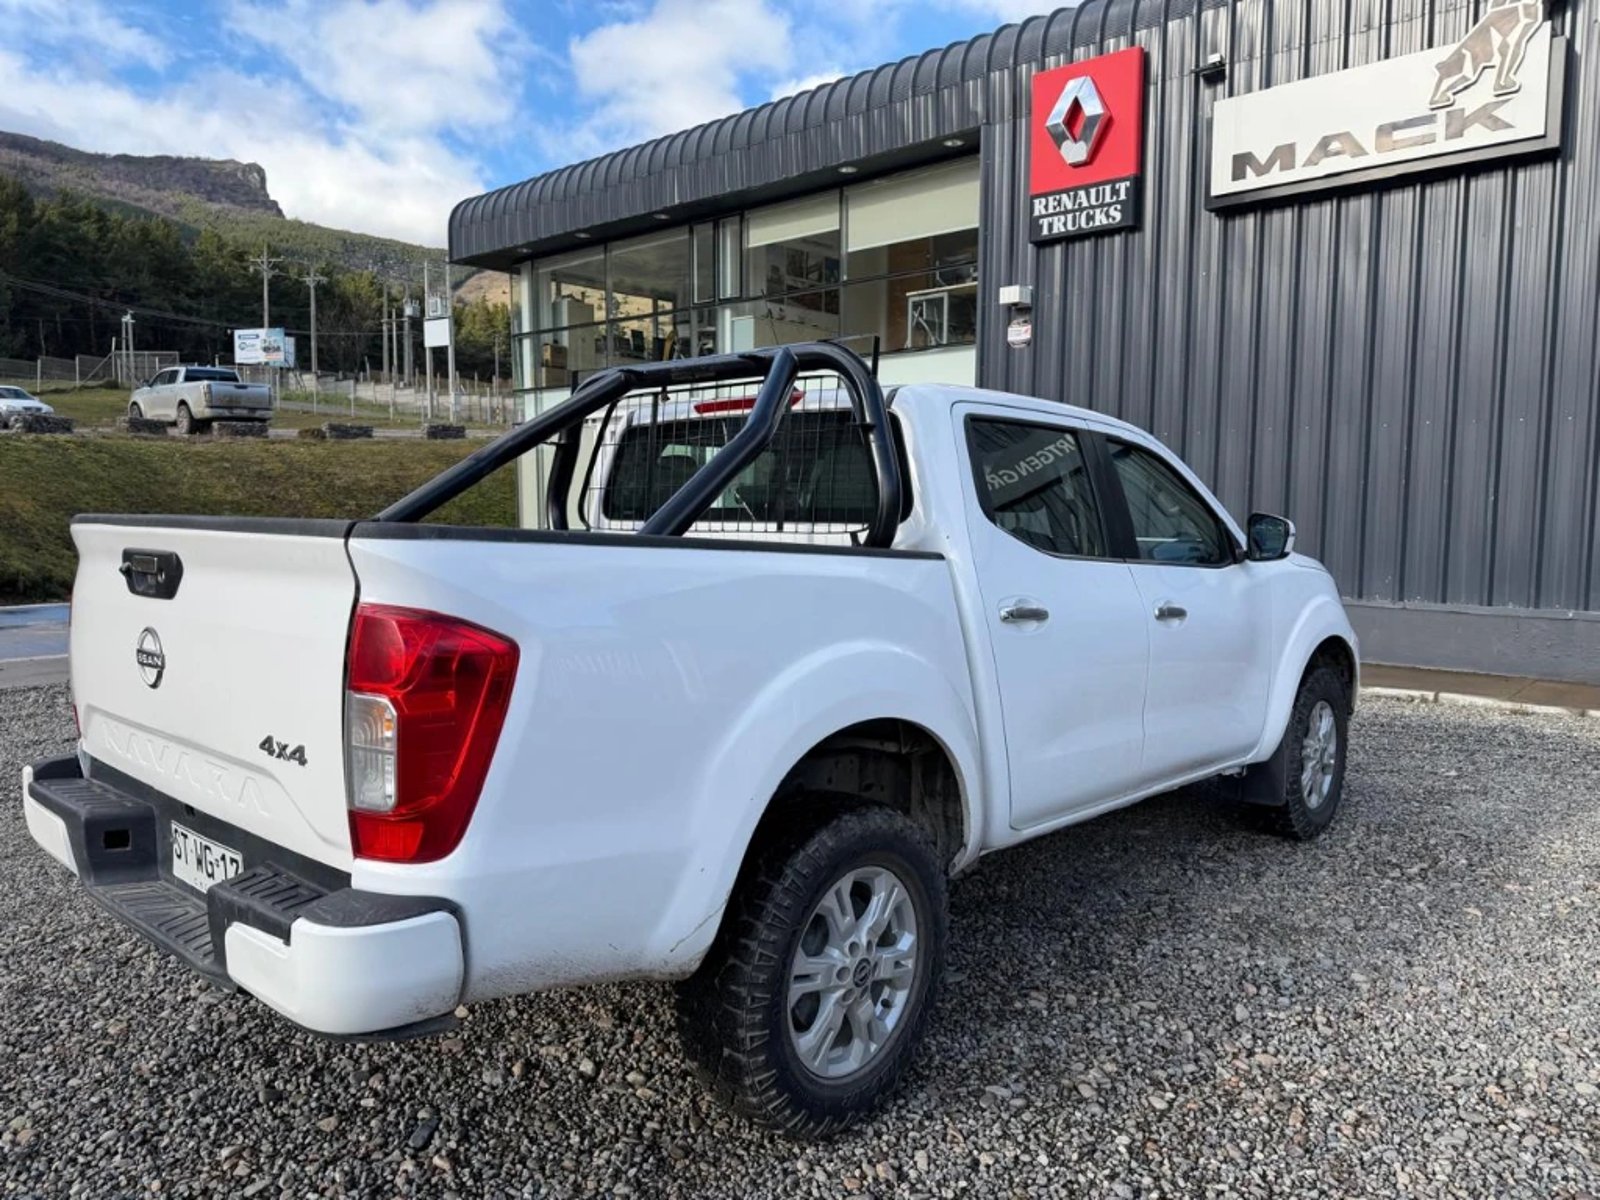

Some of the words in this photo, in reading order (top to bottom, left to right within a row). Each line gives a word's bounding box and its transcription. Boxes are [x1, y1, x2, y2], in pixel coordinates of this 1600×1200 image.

[1231, 98, 1516, 182] MACK
[1032, 181, 1130, 217] RENAULT
[1039, 203, 1122, 236] TRUCKS
[259, 734, 308, 767] 4x4
[102, 721, 270, 817] NAVARA
